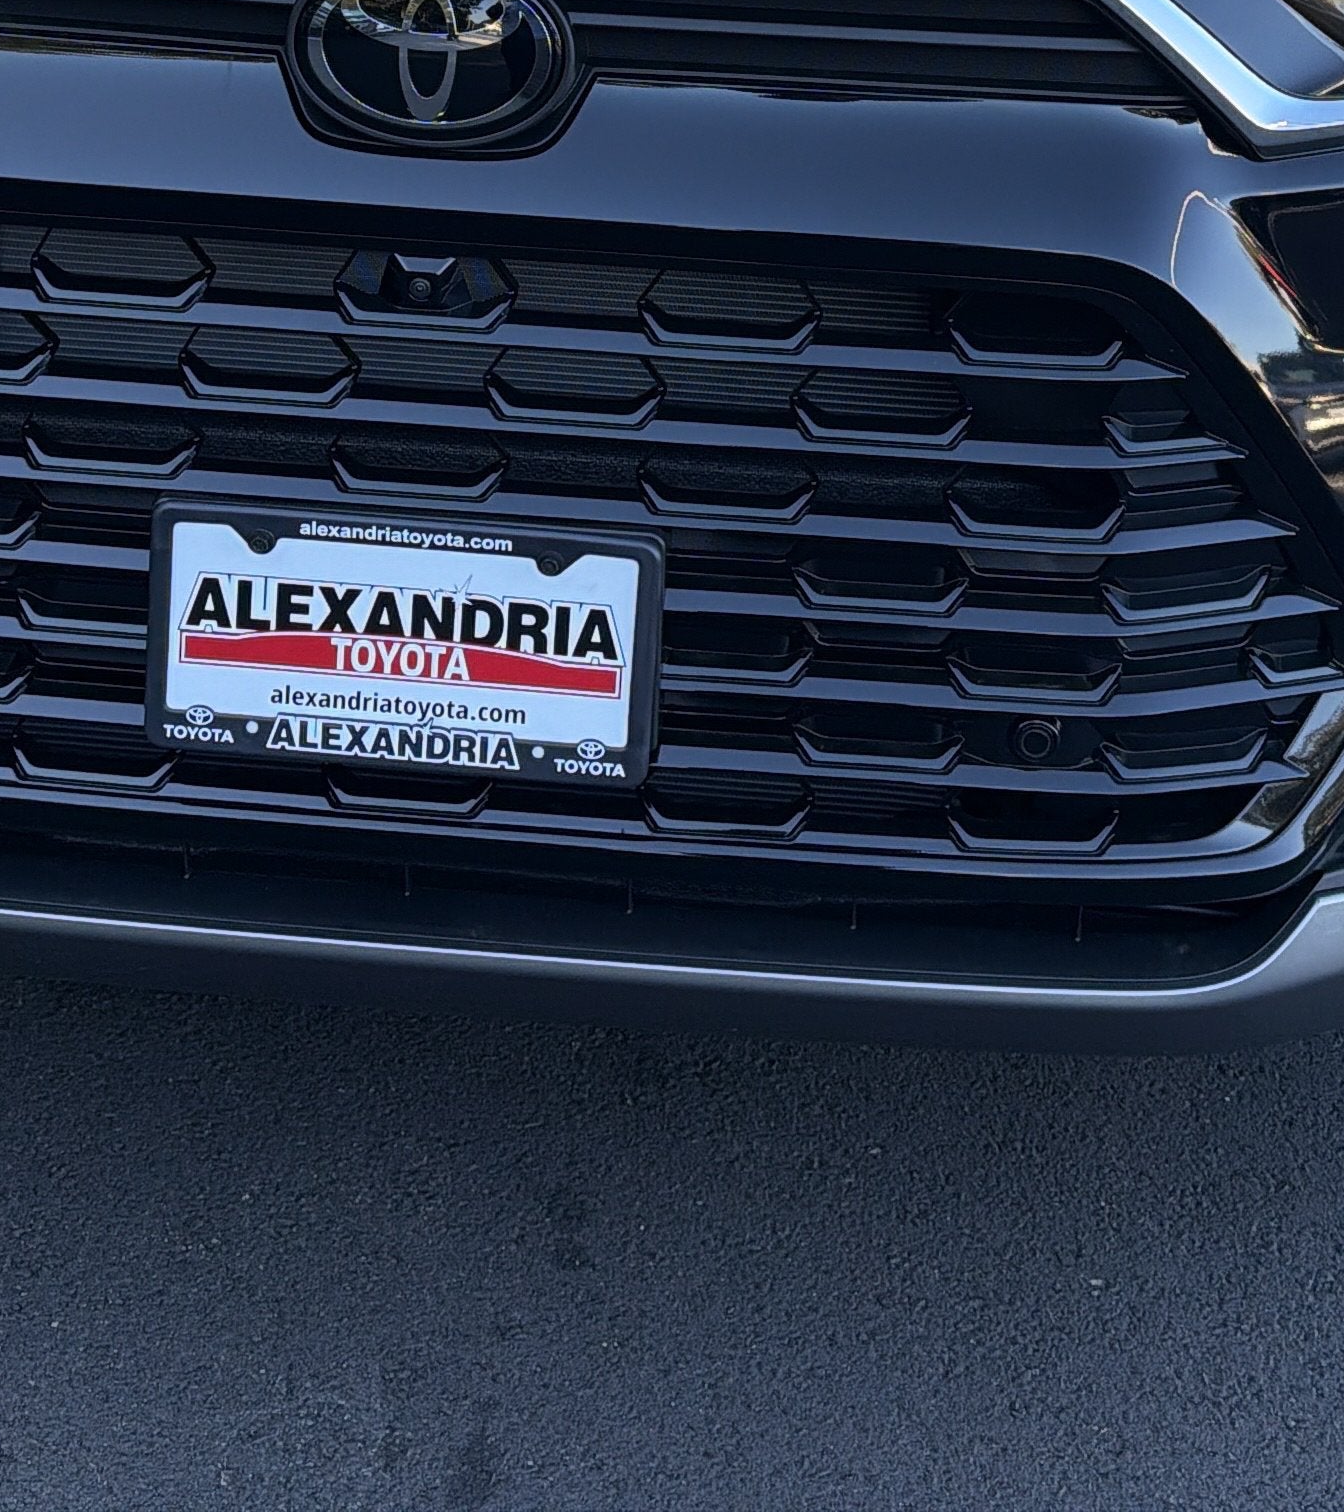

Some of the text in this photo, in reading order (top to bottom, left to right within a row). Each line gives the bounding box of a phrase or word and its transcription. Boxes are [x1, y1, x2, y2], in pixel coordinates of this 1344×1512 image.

[299, 521, 513, 551] alexandriatoyota.com
[185, 576, 620, 662] ALEXANDRIA
[330, 637, 471, 681] TOYOTA
[270, 685, 526, 725] alexandriatoyota.com
[163, 724, 235, 745] TOYOTA
[267, 714, 520, 770] ALEXANDRIA
[554, 757, 626, 779] TOYOTA
